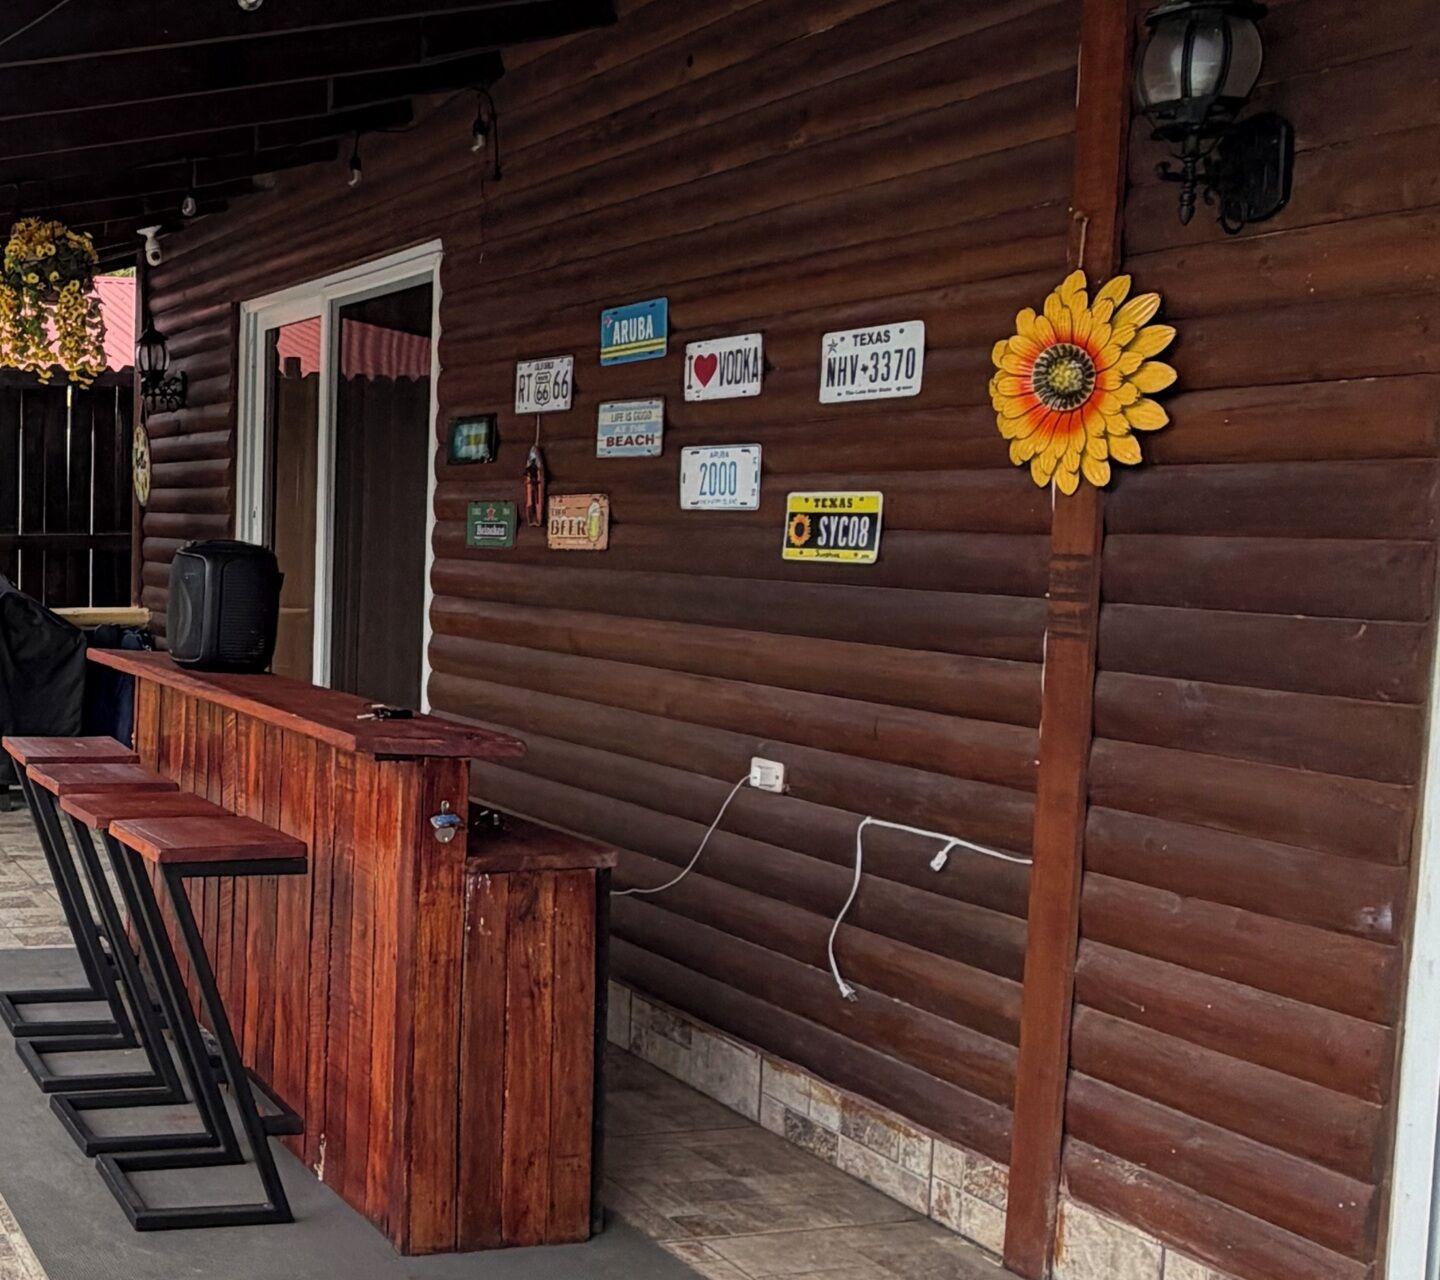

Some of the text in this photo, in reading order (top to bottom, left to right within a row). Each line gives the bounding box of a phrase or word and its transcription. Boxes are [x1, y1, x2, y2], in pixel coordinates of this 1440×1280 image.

[612, 314, 654, 345] ARUBA
[852, 329, 891, 348] TEXAS
[686, 346, 759, 390] I VODKA
[869, 347, 916, 384] 3370
[518, 369, 569, 404] RT 66
[536, 383, 549, 401] 66
[606, 433, 655, 448] BEACH
[699, 461, 737, 496] 2000
[813, 497, 853, 508] TEXAS
[551, 519, 586, 536] BEER
